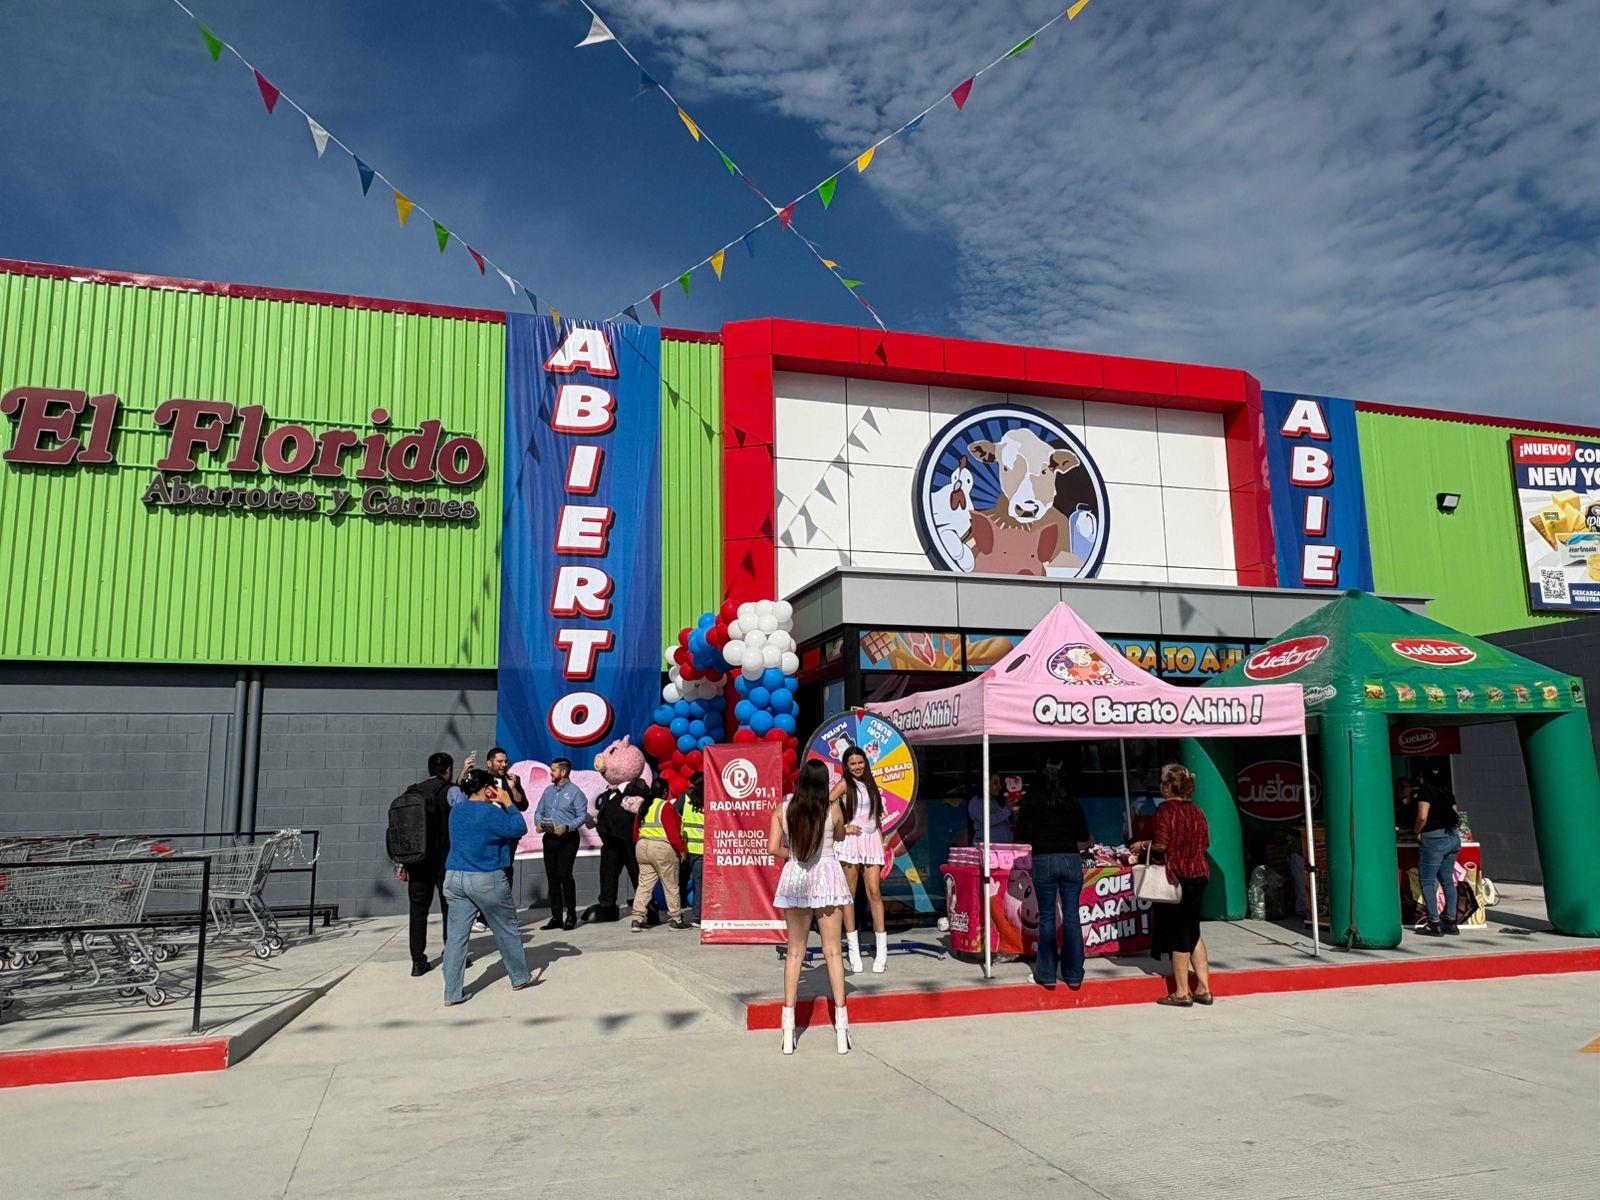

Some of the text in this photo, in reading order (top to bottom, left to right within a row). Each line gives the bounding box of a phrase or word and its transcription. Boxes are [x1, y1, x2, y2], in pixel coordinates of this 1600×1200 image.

[1, 386, 486, 484] El Florido
[1520, 443, 1571, 457] ¡NUEVO!
[1528, 467, 1577, 486] NEW
[142, 473, 477, 519] Abarrotes y Carnes
[1280, 399, 1341, 586] ABIE
[544, 328, 617, 746] ABIERTO
[893, 708, 921, 732] Barato
[1033, 694, 1089, 725] Que
[1092, 695, 1178, 725] Barato
[755, 786, 776, 798] 91.1
[714, 829, 764, 838] UNA RADIO
[717, 855, 775, 866] RADIANTE
[1095, 873, 1131, 896] QUE
[1079, 896, 1153, 924] BARATO
